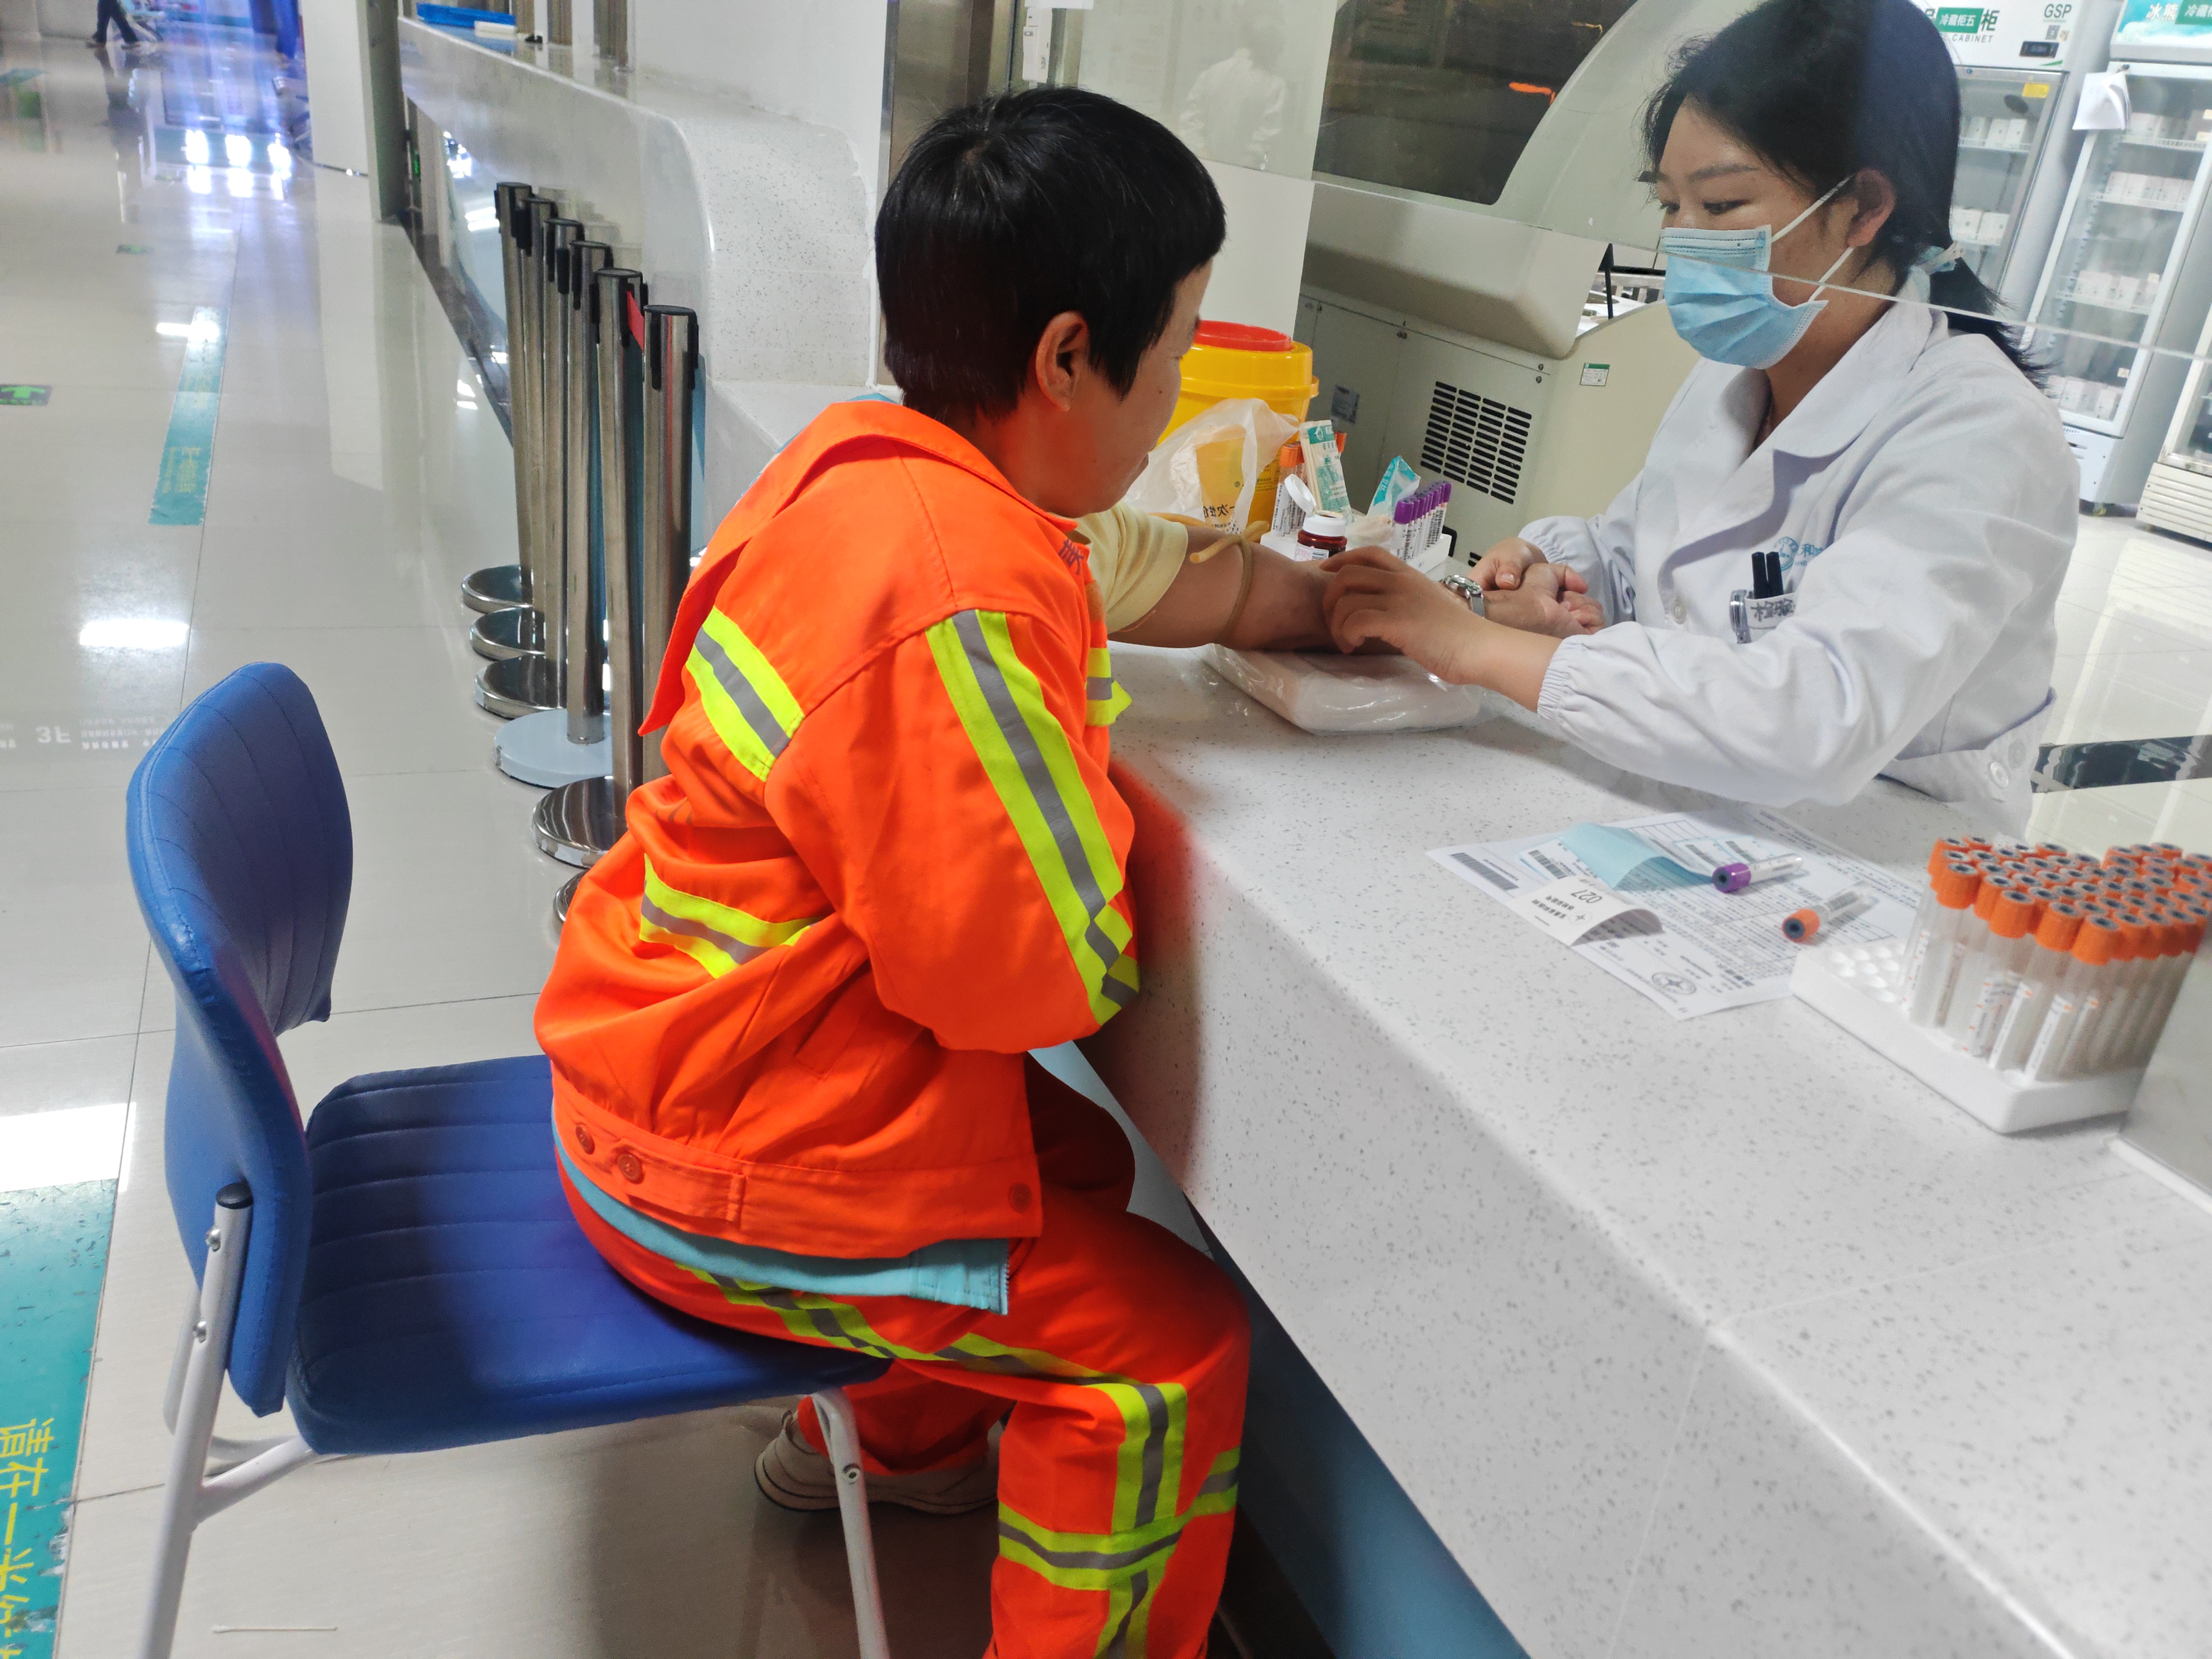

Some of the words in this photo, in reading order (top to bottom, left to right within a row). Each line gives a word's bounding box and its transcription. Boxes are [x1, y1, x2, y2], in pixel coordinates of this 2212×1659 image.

[2044, 4, 2072, 18] GSP
[2146, 3, 2179, 21] 冰熊
[1952, 34, 1993, 43] CABINET
[1570, 889, 1603, 903] 027
